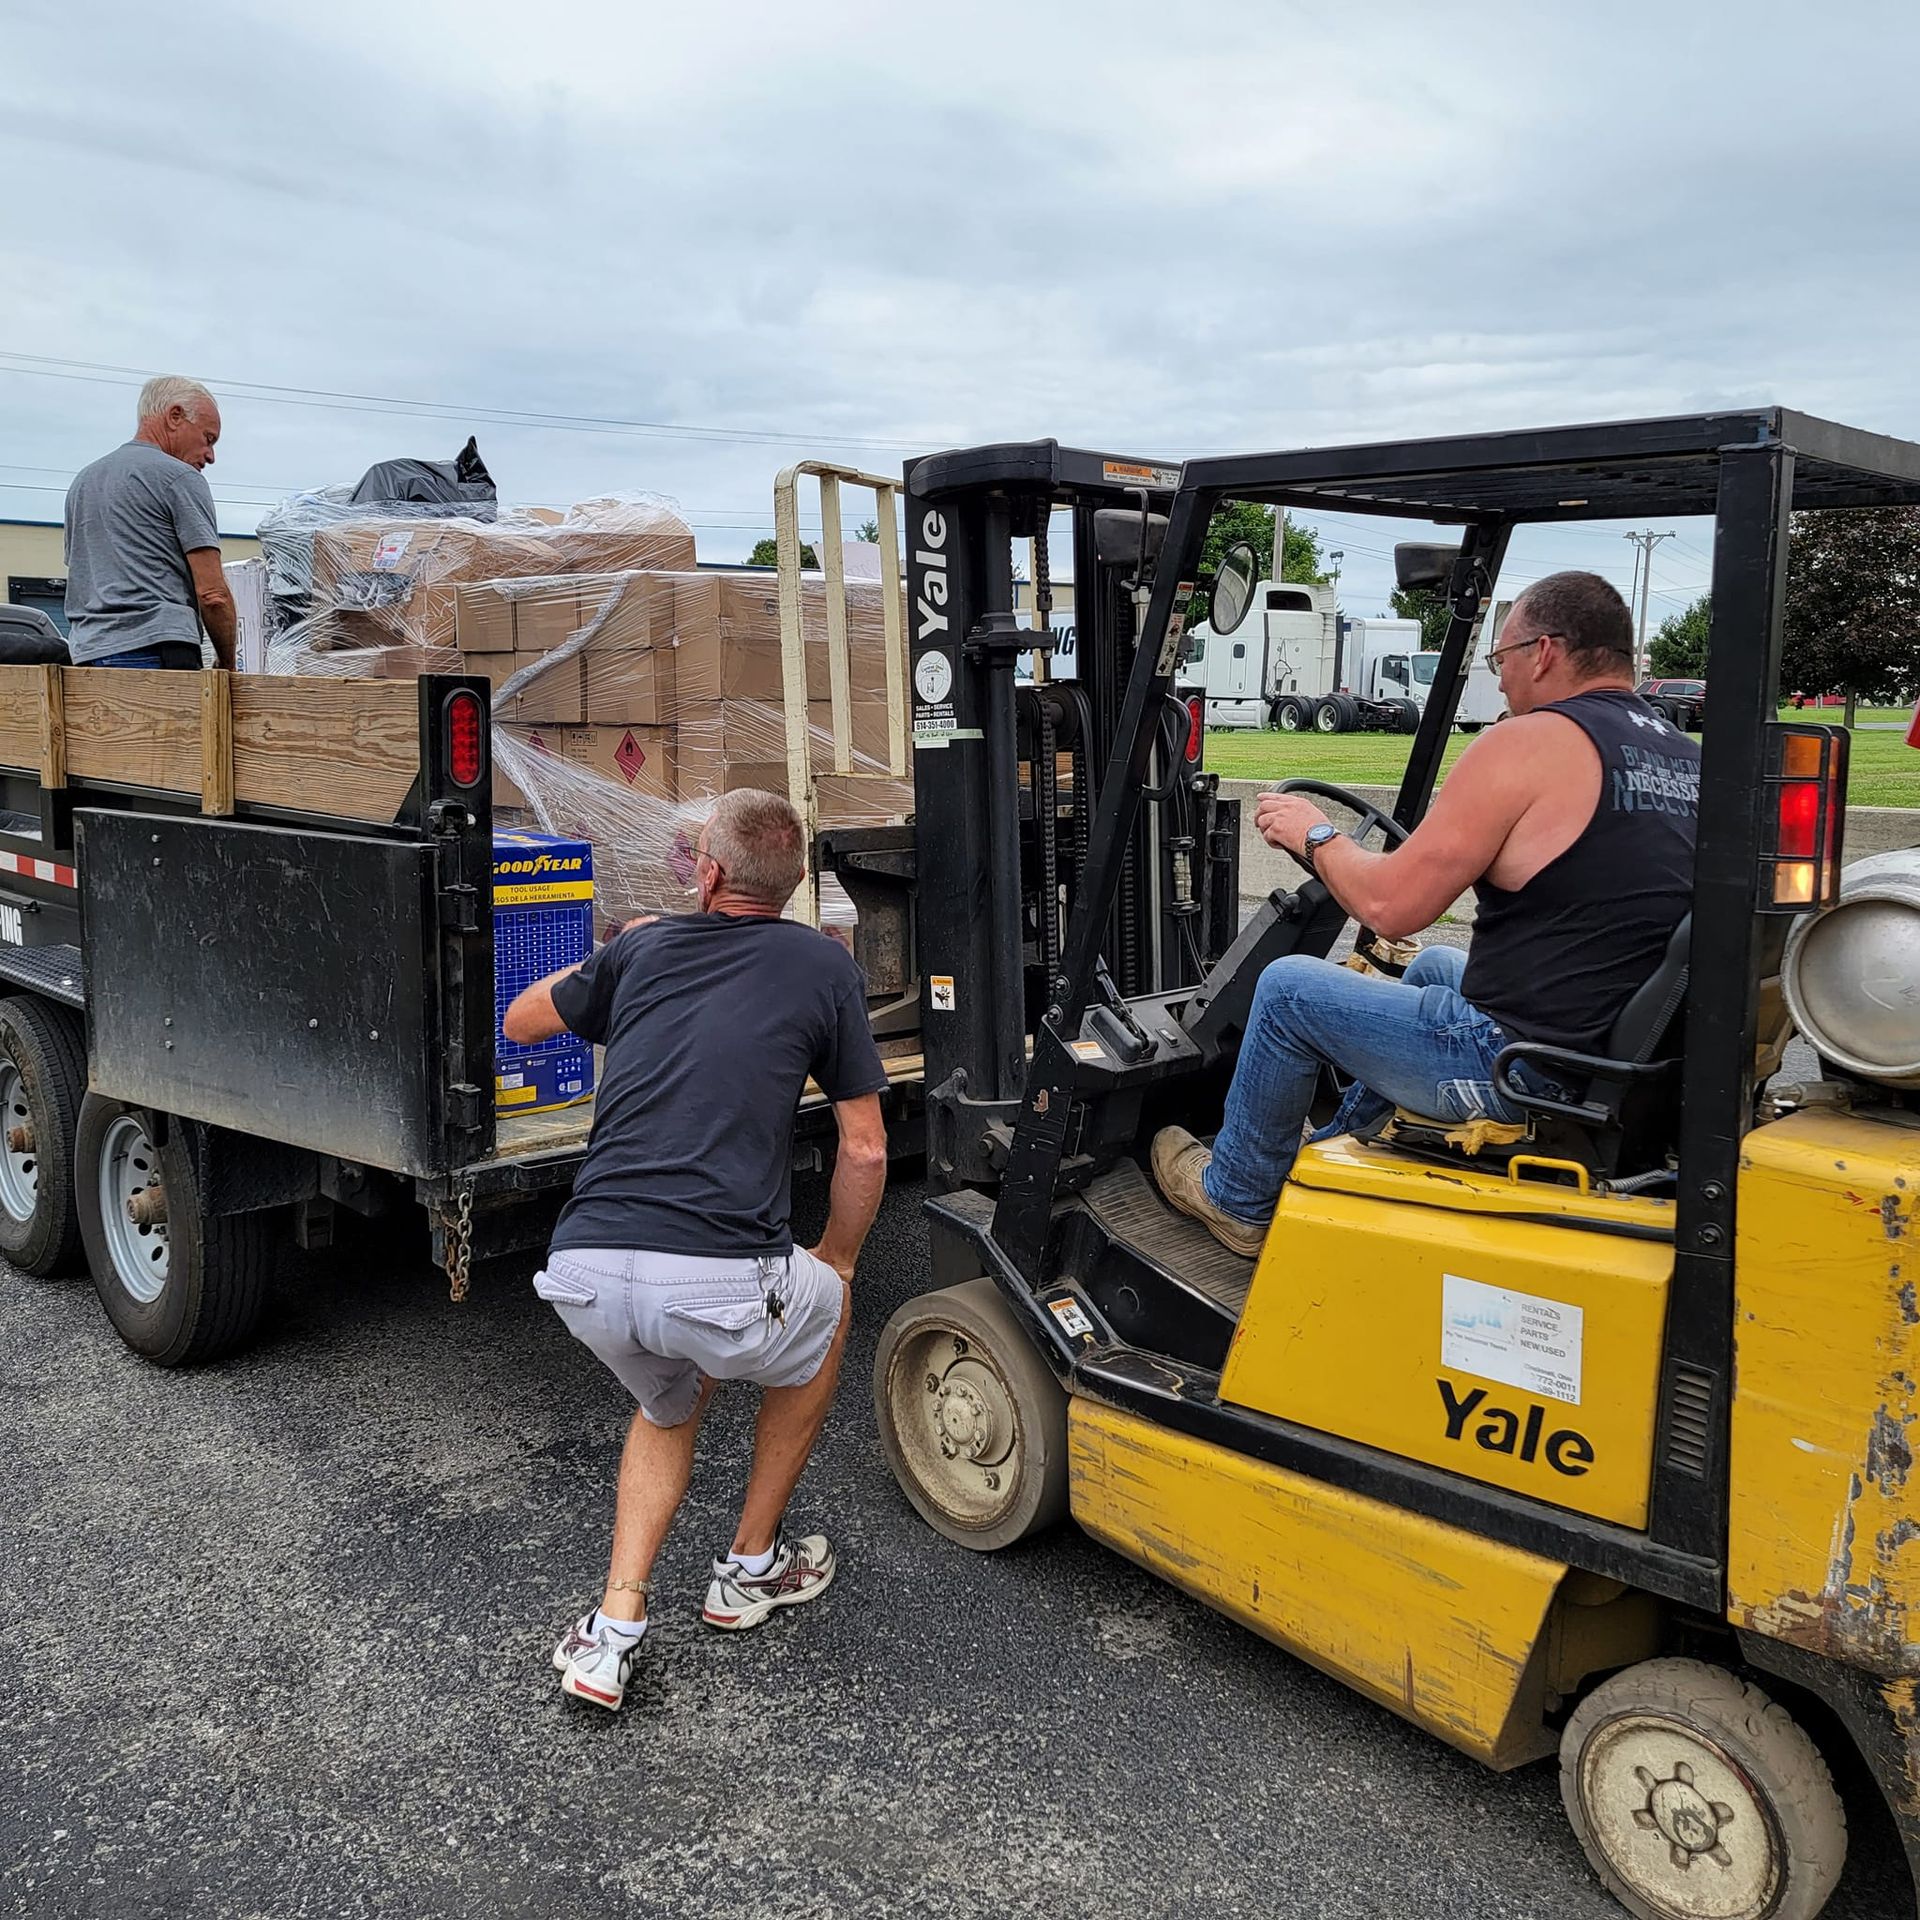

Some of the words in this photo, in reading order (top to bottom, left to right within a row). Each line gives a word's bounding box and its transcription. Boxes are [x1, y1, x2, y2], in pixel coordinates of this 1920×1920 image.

[915, 509, 949, 640] Yale
[1625, 771, 1700, 802] NECESSA
[529, 892, 575, 900] HERRAMIENTA
[0, 903, 23, 947] ING
[1520, 1315, 1559, 1331] SERVICE
[1521, 1303, 1561, 1321] RENTALS
[1520, 1327, 1550, 1341] PARTS
[1436, 1379, 1595, 1477] Yale
